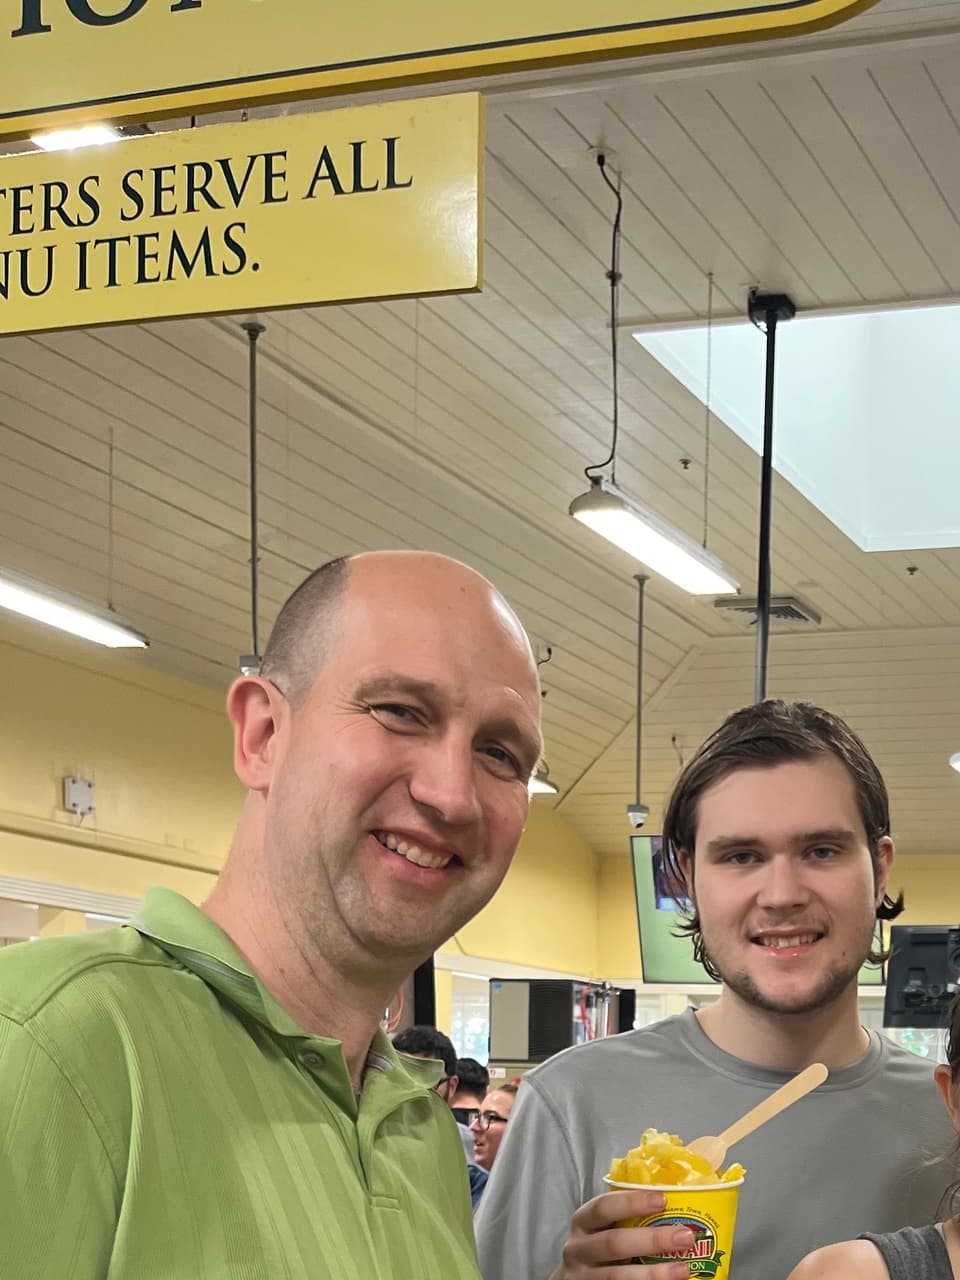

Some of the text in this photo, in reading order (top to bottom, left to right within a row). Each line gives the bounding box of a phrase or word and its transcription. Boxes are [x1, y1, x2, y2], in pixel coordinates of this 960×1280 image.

[0, 136, 414, 236] ERS SERVE ALL
[75, 222, 261, 291] ITEMS.
